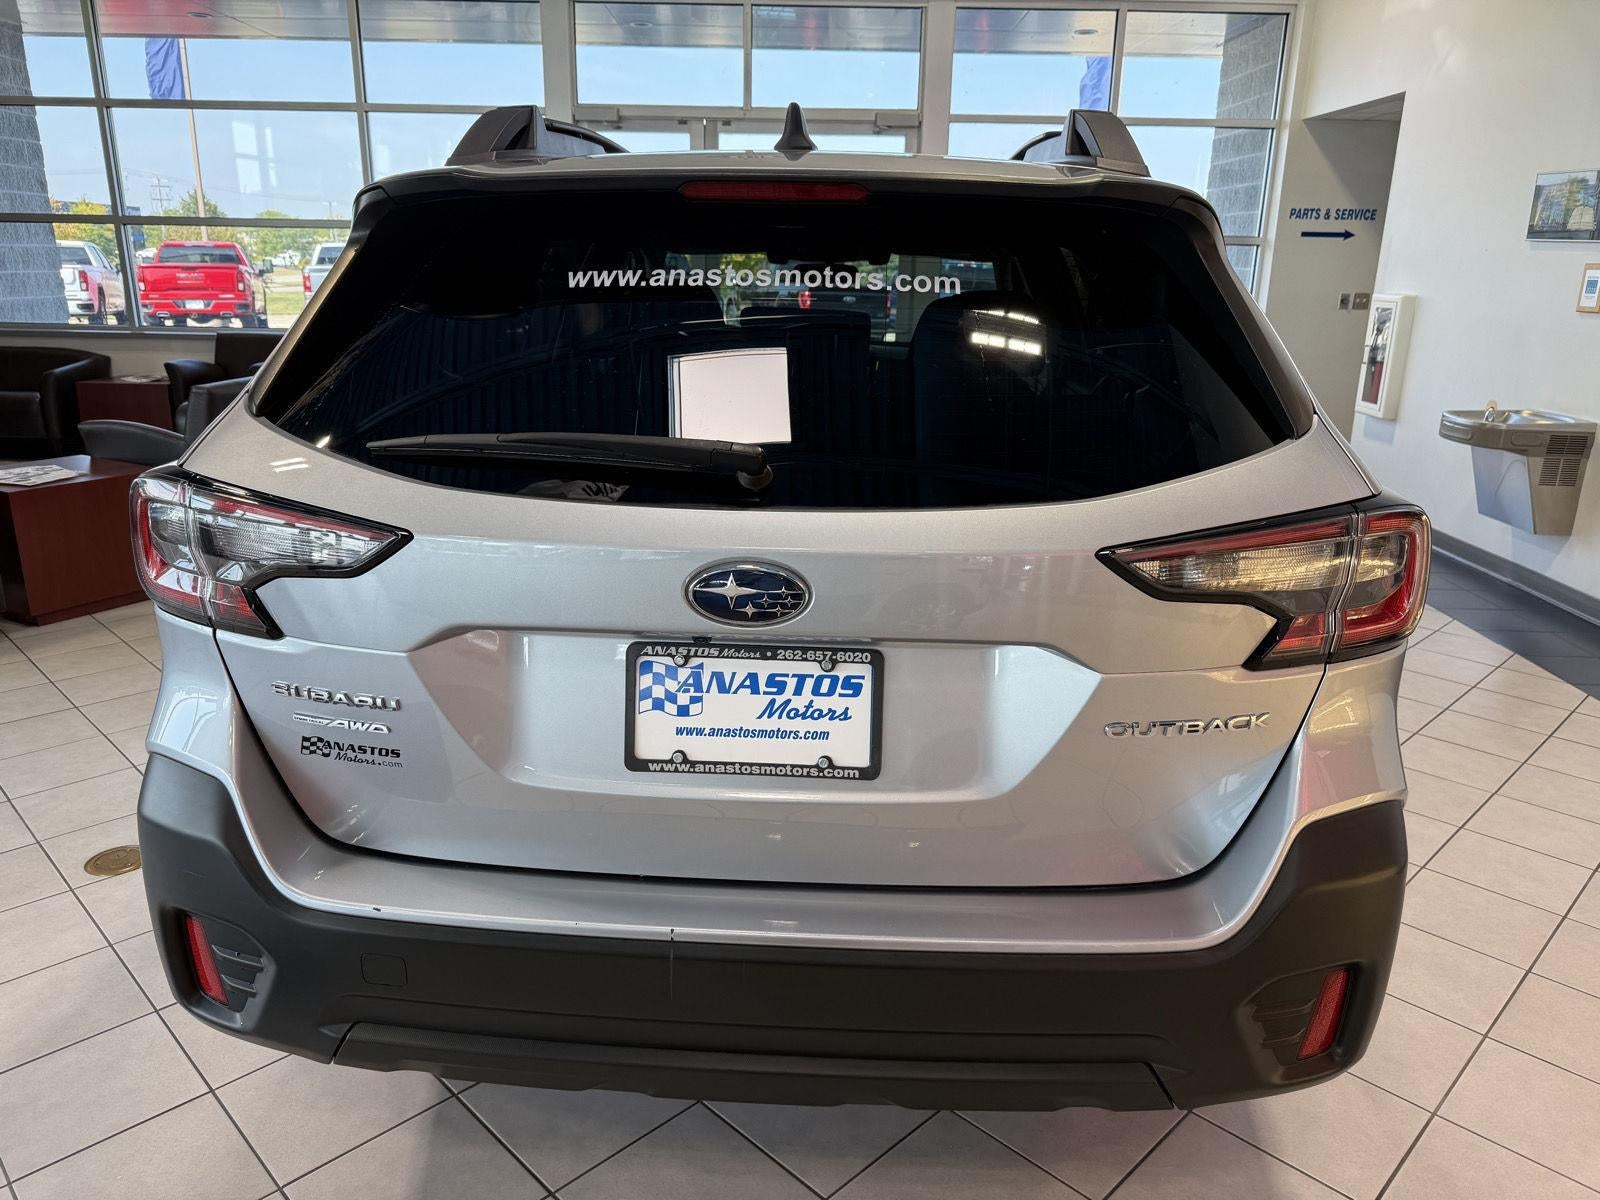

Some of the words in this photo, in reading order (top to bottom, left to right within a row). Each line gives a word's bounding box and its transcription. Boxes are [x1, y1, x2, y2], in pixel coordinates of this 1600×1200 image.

[1289, 208, 1321, 220] PARTS
[1323, 208, 1331, 220] &
[1334, 208, 1377, 221] SERVICE
[567, 265, 962, 295] www.anastosmotors.com
[641, 645, 720, 657] ANASTOS
[720, 648, 761, 659] Motors
[776, 649, 871, 663] 262-657-6020
[674, 669, 865, 698] ANASTOS
[270, 681, 402, 712] SUBARU
[755, 698, 853, 722] Motors
[327, 718, 392, 734] AWD
[675, 725, 830, 741] www.anastosmotors.com
[1104, 711, 1270, 738] OUTBACK
[321, 740, 401, 758] ANASTOS
[648, 762, 860, 778] www.anastosmotors.com
